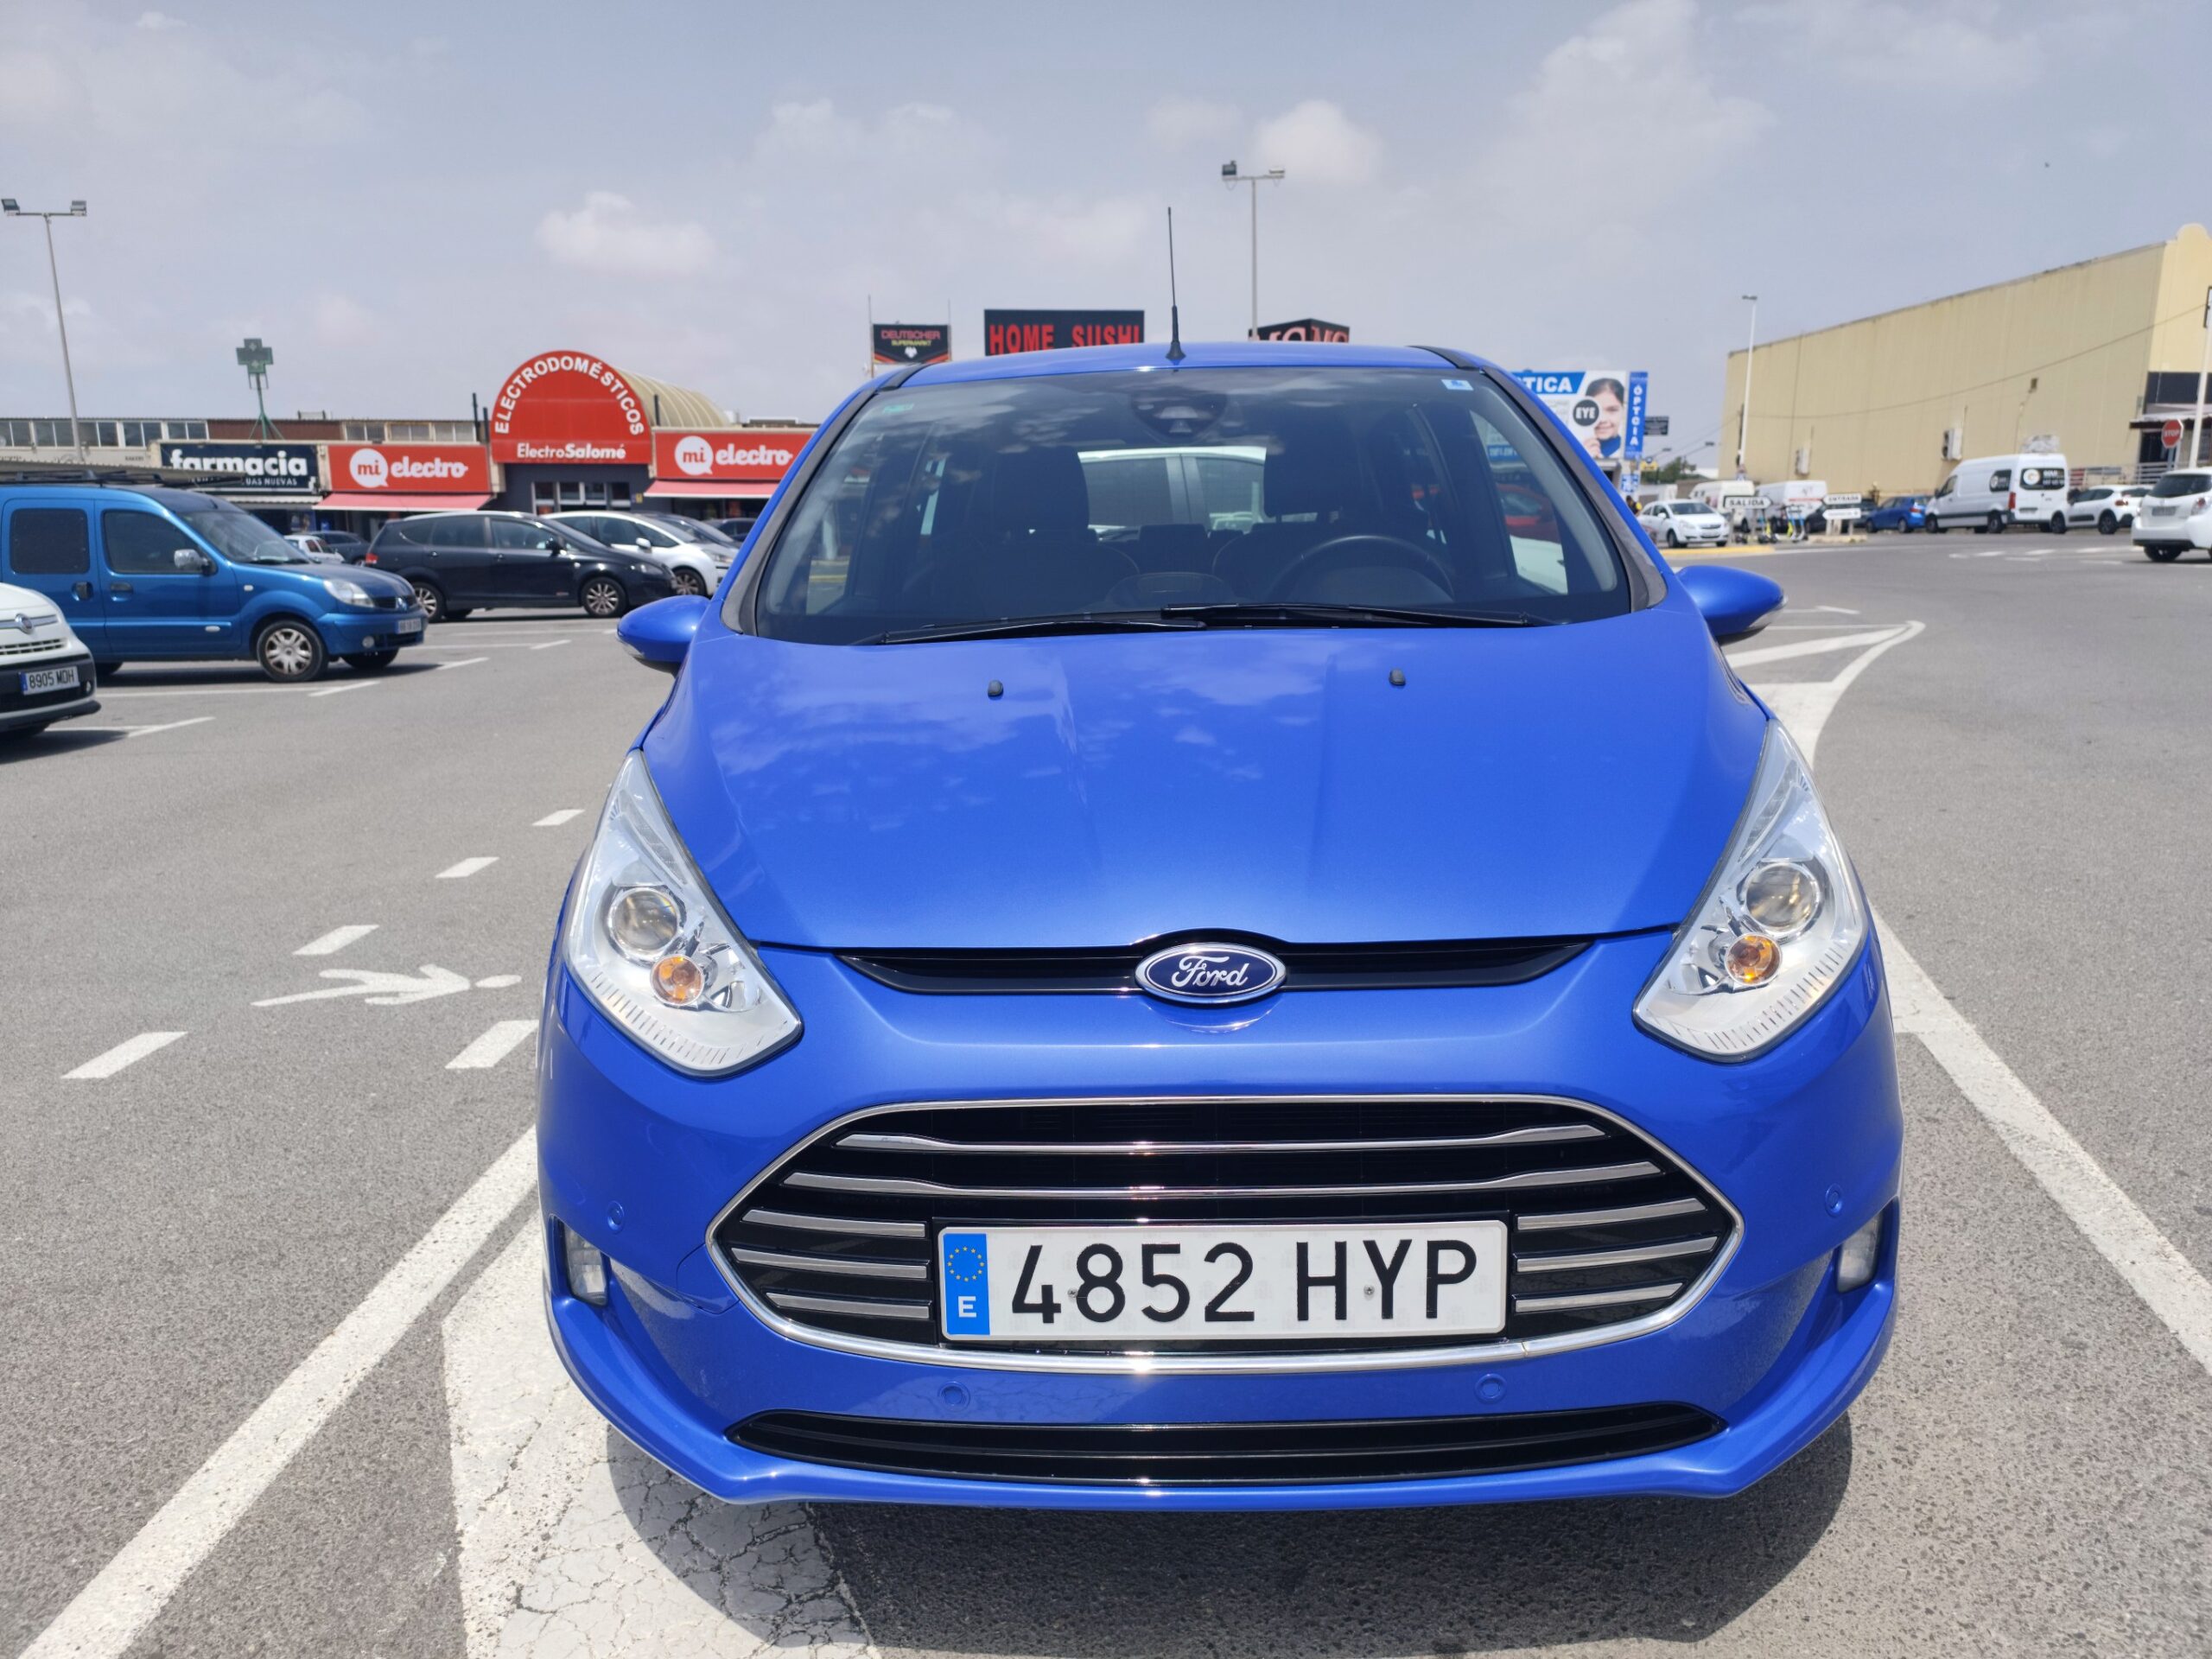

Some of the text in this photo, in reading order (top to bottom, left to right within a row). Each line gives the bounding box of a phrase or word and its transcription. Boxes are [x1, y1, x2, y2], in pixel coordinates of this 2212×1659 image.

[880, 329, 941, 340] DEUTSCHER
[989, 323, 1140, 355] HOME SUSHI
[494, 355, 645, 435] ELECTRODOMÉSTICOS
[1575, 406, 1596, 420] EYE
[170, 448, 308, 476] farmacia
[517, 442, 626, 460] ElectroSalomé
[683, 442, 793, 466] mi electro
[357, 455, 469, 478] mi electro
[244, 477, 297, 486] UAS NUEVAS
[29, 669, 75, 690] 8905 MDH
[1172, 956, 1249, 987] Ford
[1012, 1239, 1478, 1324] 4852 HYP
[957, 1295, 977, 1318] E
